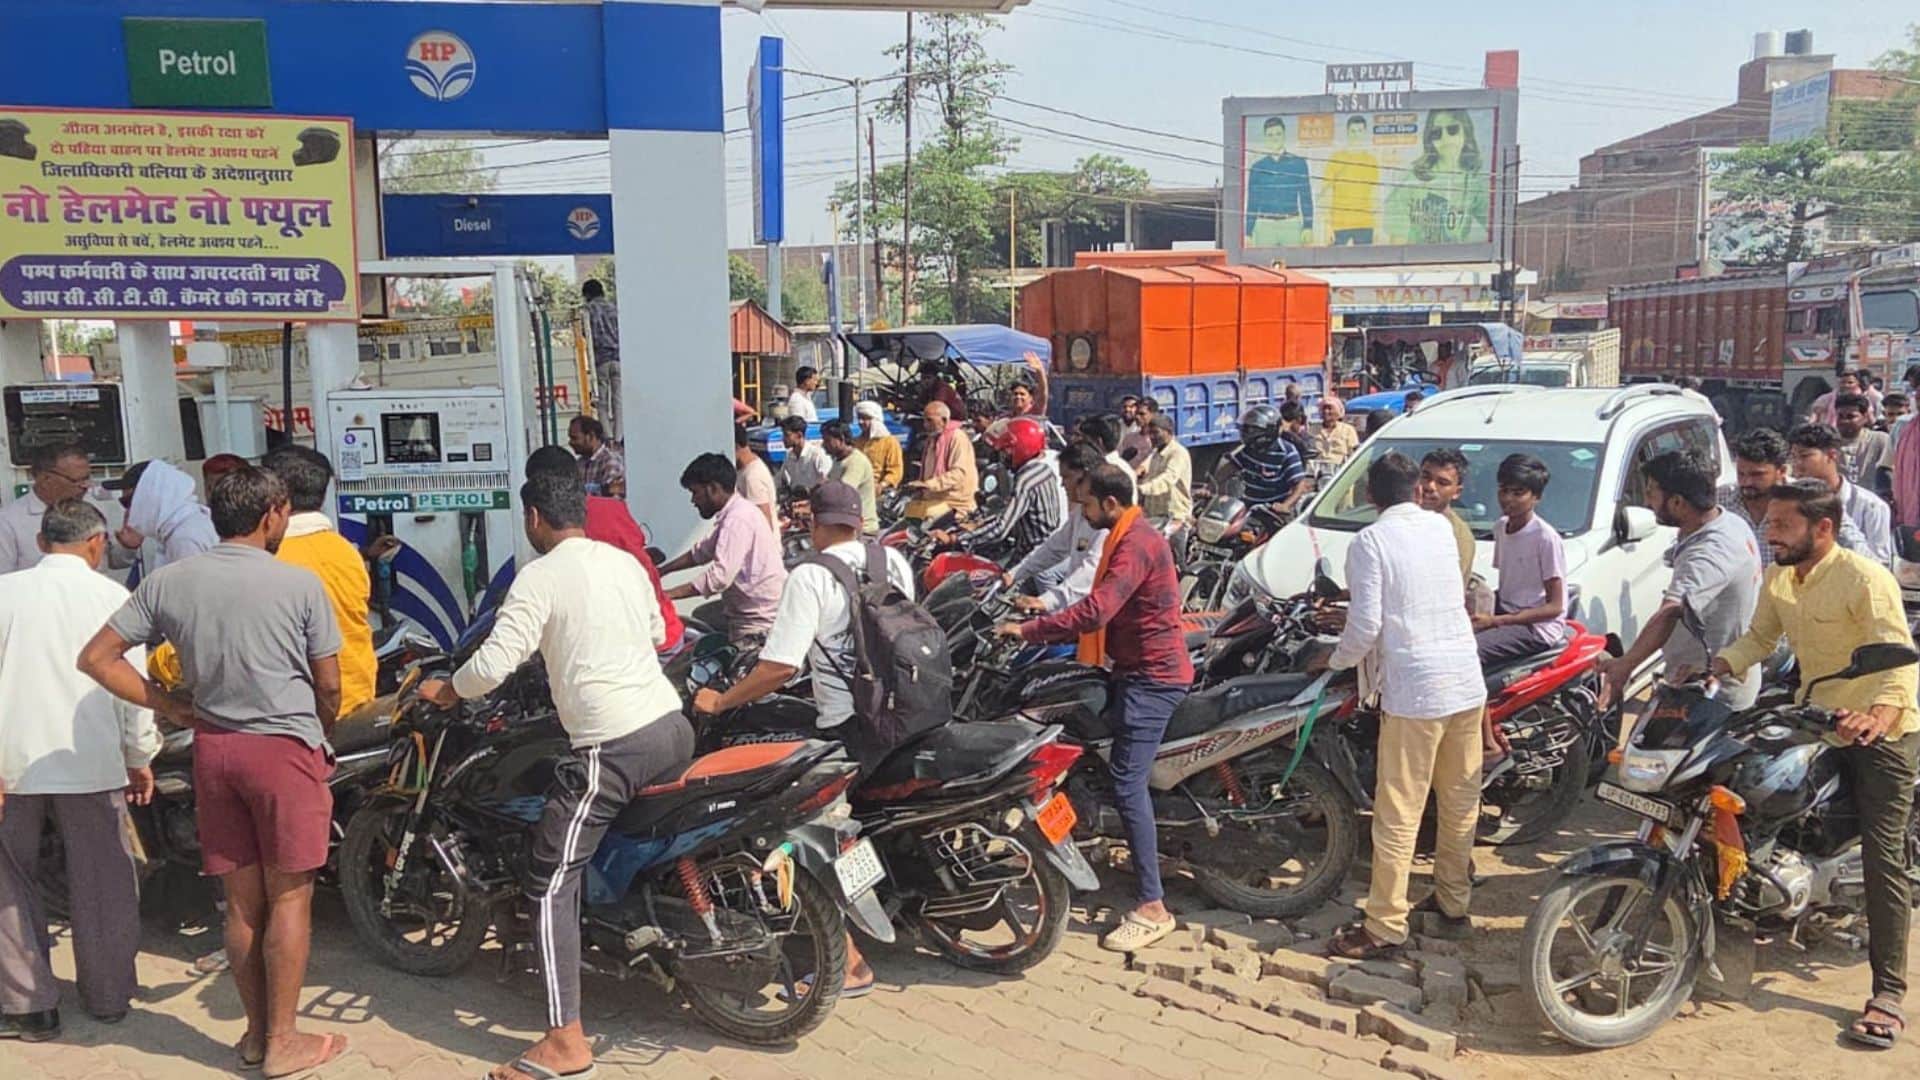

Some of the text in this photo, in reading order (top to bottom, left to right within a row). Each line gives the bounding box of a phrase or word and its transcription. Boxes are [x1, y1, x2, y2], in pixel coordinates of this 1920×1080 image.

[419, 41, 457, 62] HP
[159, 49, 236, 75] Petrol
[1360, 64, 1404, 79] PLAZA
[1367, 91, 1402, 110] MALL
[62, 121, 99, 135] जीवन
[104, 122, 154, 136] अनमोल
[177, 124, 213, 138] इसकी
[51, 140, 64, 155] दो
[69, 141, 106, 155] पहिया
[111, 144, 141, 156] वाहन
[146, 145, 161, 156] पर
[166, 144, 206, 158] हेलमेट
[210, 146, 247, 159] अवश्य
[42, 160, 133, 178] जिलाधिकारी
[140, 162, 187, 179] बलिया
[192, 164, 206, 179] के
[2, 185, 332, 238] नो हेलमेट नो फ्यूल
[574, 211, 593, 222] HP
[454, 218, 491, 233] Diesel
[65, 233, 114, 250] असुविधा
[118, 233, 128, 247] से
[160, 234, 195, 248] हेलमेट
[200, 236, 235, 248] अवश्य
[20, 260, 321, 282] पम्प कर्मचारी के साथ जबरदस्ती ना करें
[21, 289, 59, 305] आप
[225, 287, 249, 307] की
[252, 291, 291, 307] नजर
[353, 492, 491, 511] Petrol PETROL
